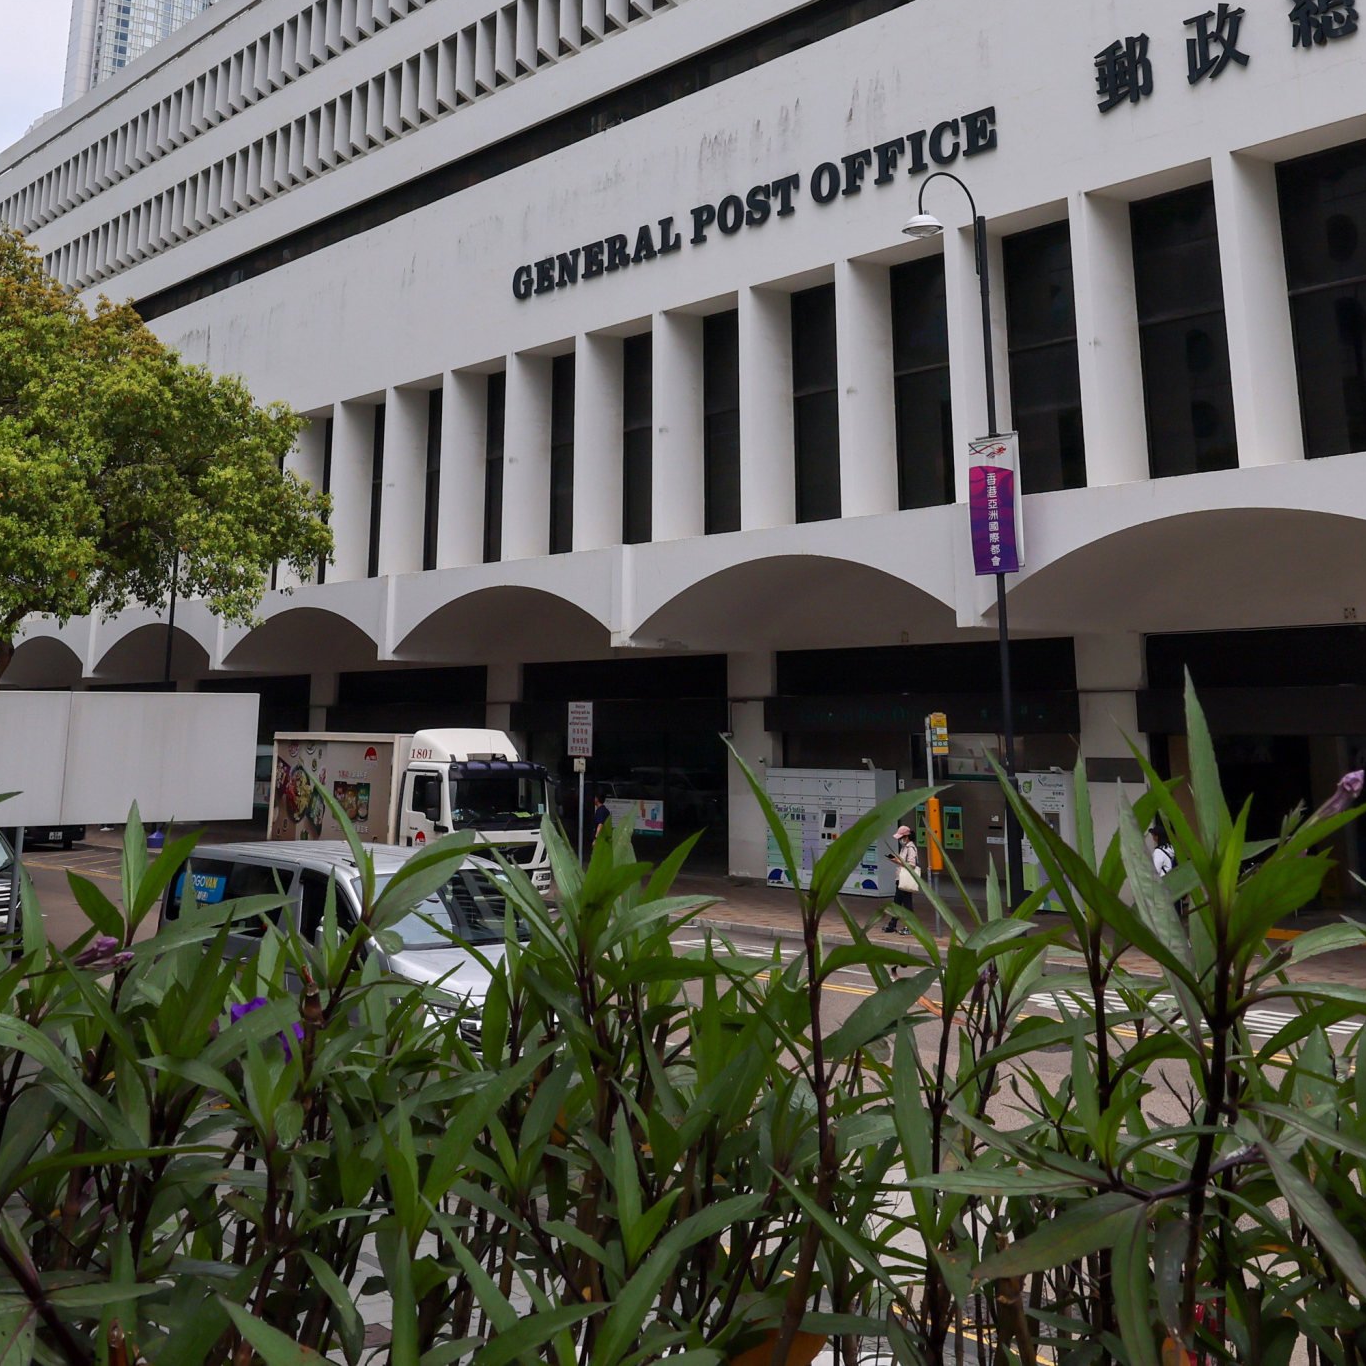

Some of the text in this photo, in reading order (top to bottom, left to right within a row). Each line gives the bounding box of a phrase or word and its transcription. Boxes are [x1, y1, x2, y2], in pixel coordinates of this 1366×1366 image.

[512, 106, 998, 300] GENERAL POST OFFICE
[986, 472, 1001, 567] 香港亞洲國際都會
[411, 749, 433, 760] 1801
